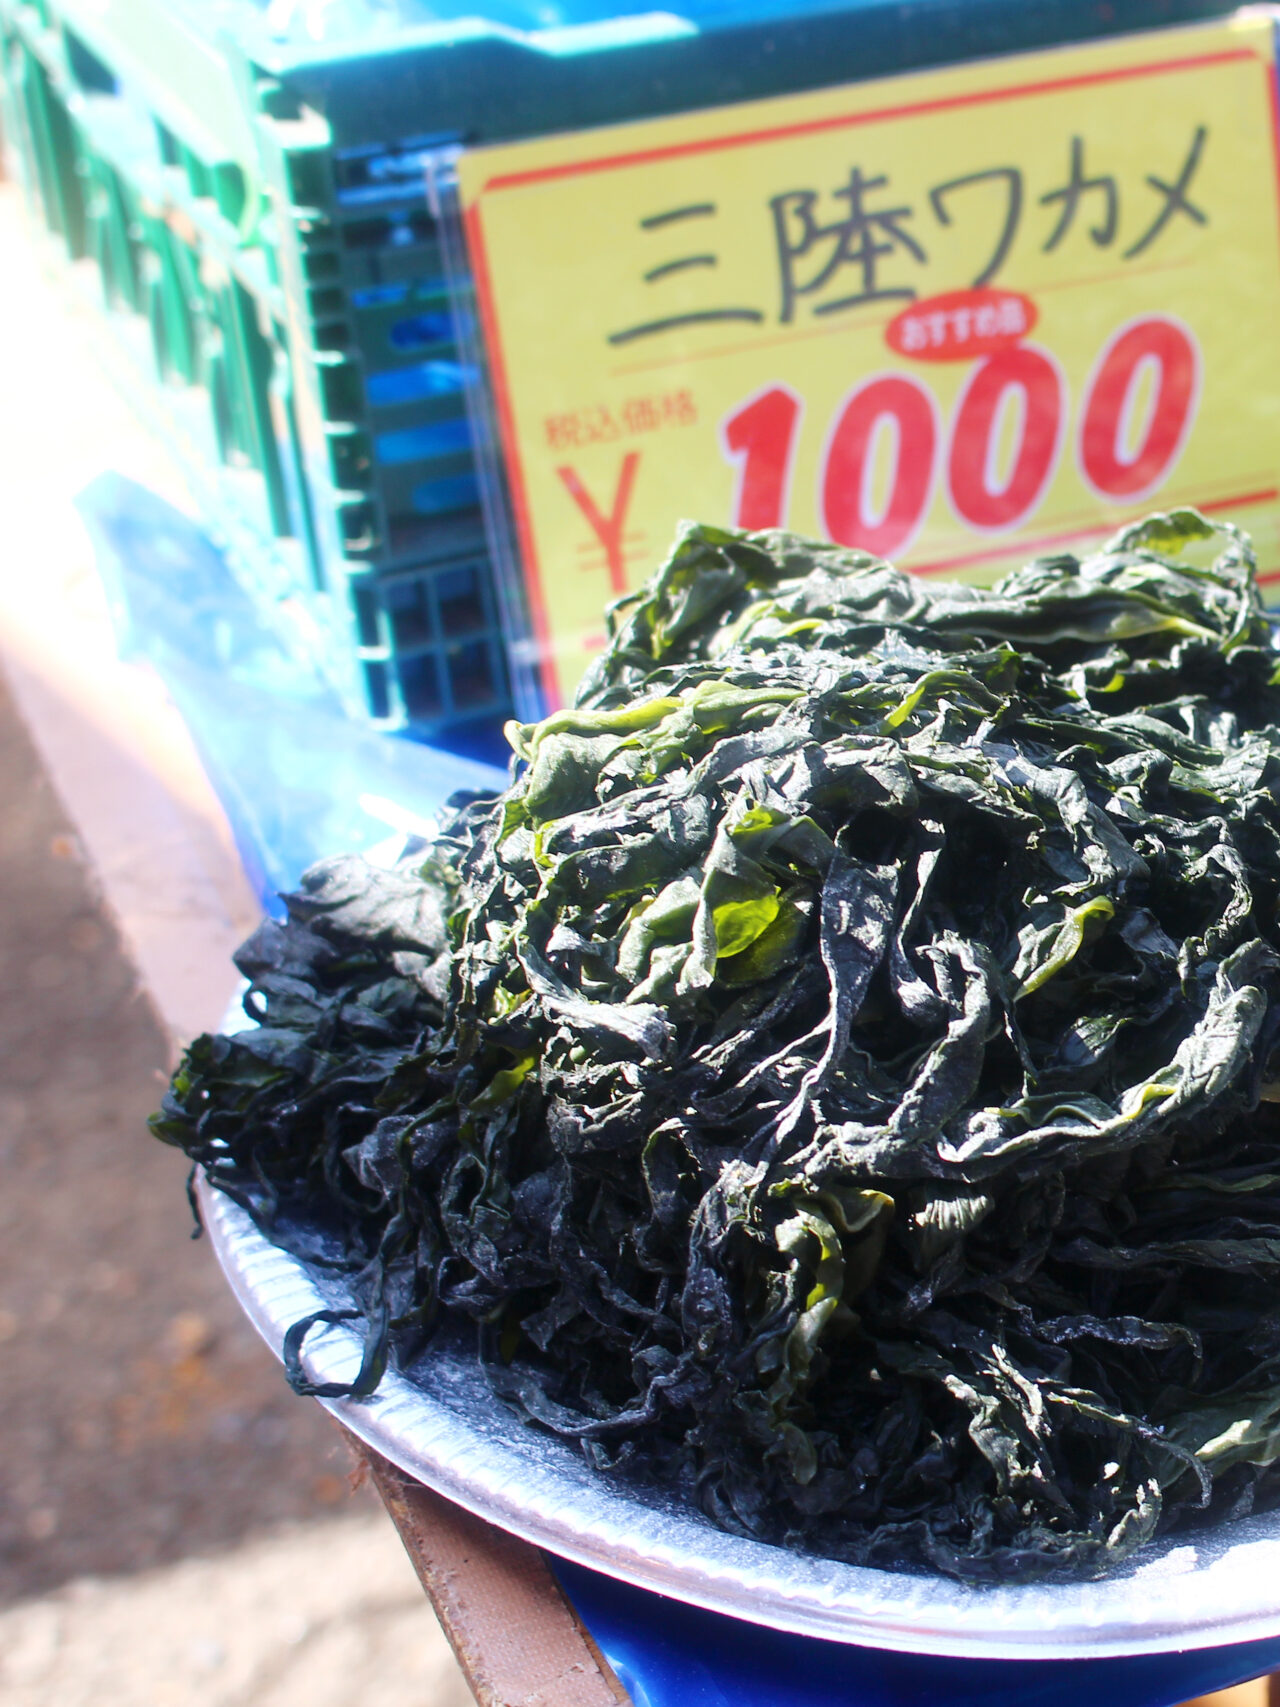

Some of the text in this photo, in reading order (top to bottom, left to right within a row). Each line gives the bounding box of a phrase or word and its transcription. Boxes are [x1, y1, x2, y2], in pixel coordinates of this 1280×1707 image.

[606, 124, 1210, 347] 三陸ワカメ
